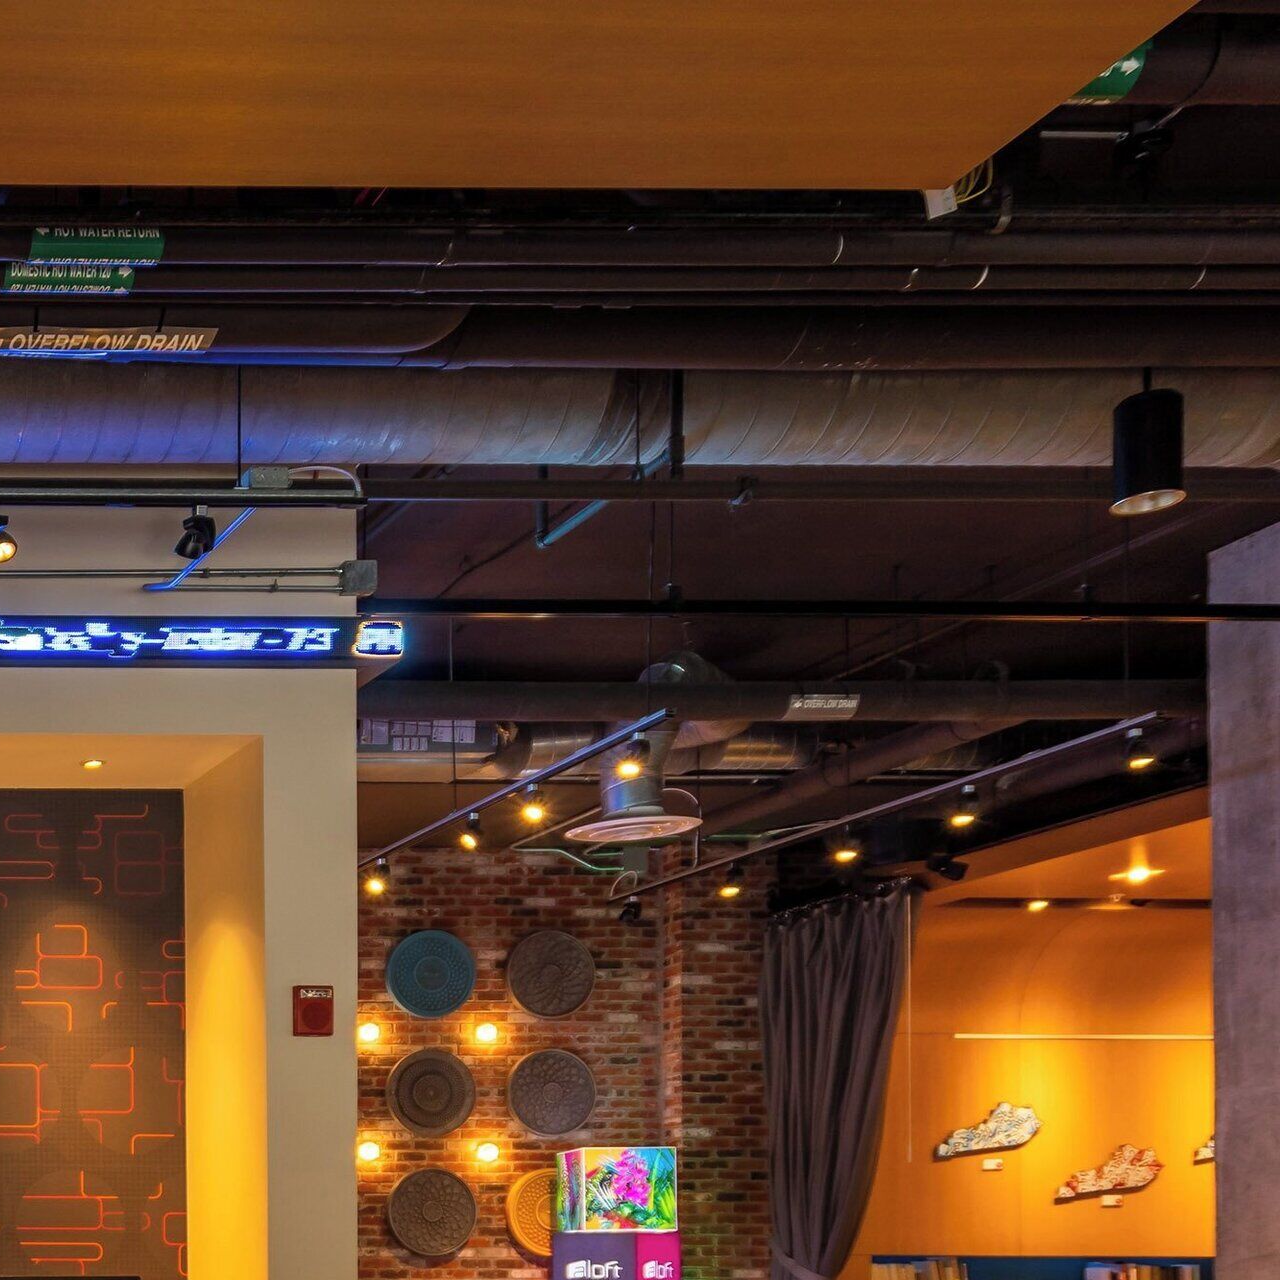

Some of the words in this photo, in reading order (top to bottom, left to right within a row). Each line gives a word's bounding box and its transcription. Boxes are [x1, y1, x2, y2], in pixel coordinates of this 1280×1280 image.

[79, 227, 115, 238] WATER
[11, 262, 51, 278] DOMESTIC
[52, 263, 67, 277] HOT
[69, 264, 97, 278] WATER
[8, 334, 131, 352] OVERFLOW
[133, 334, 205, 352] DRAIN
